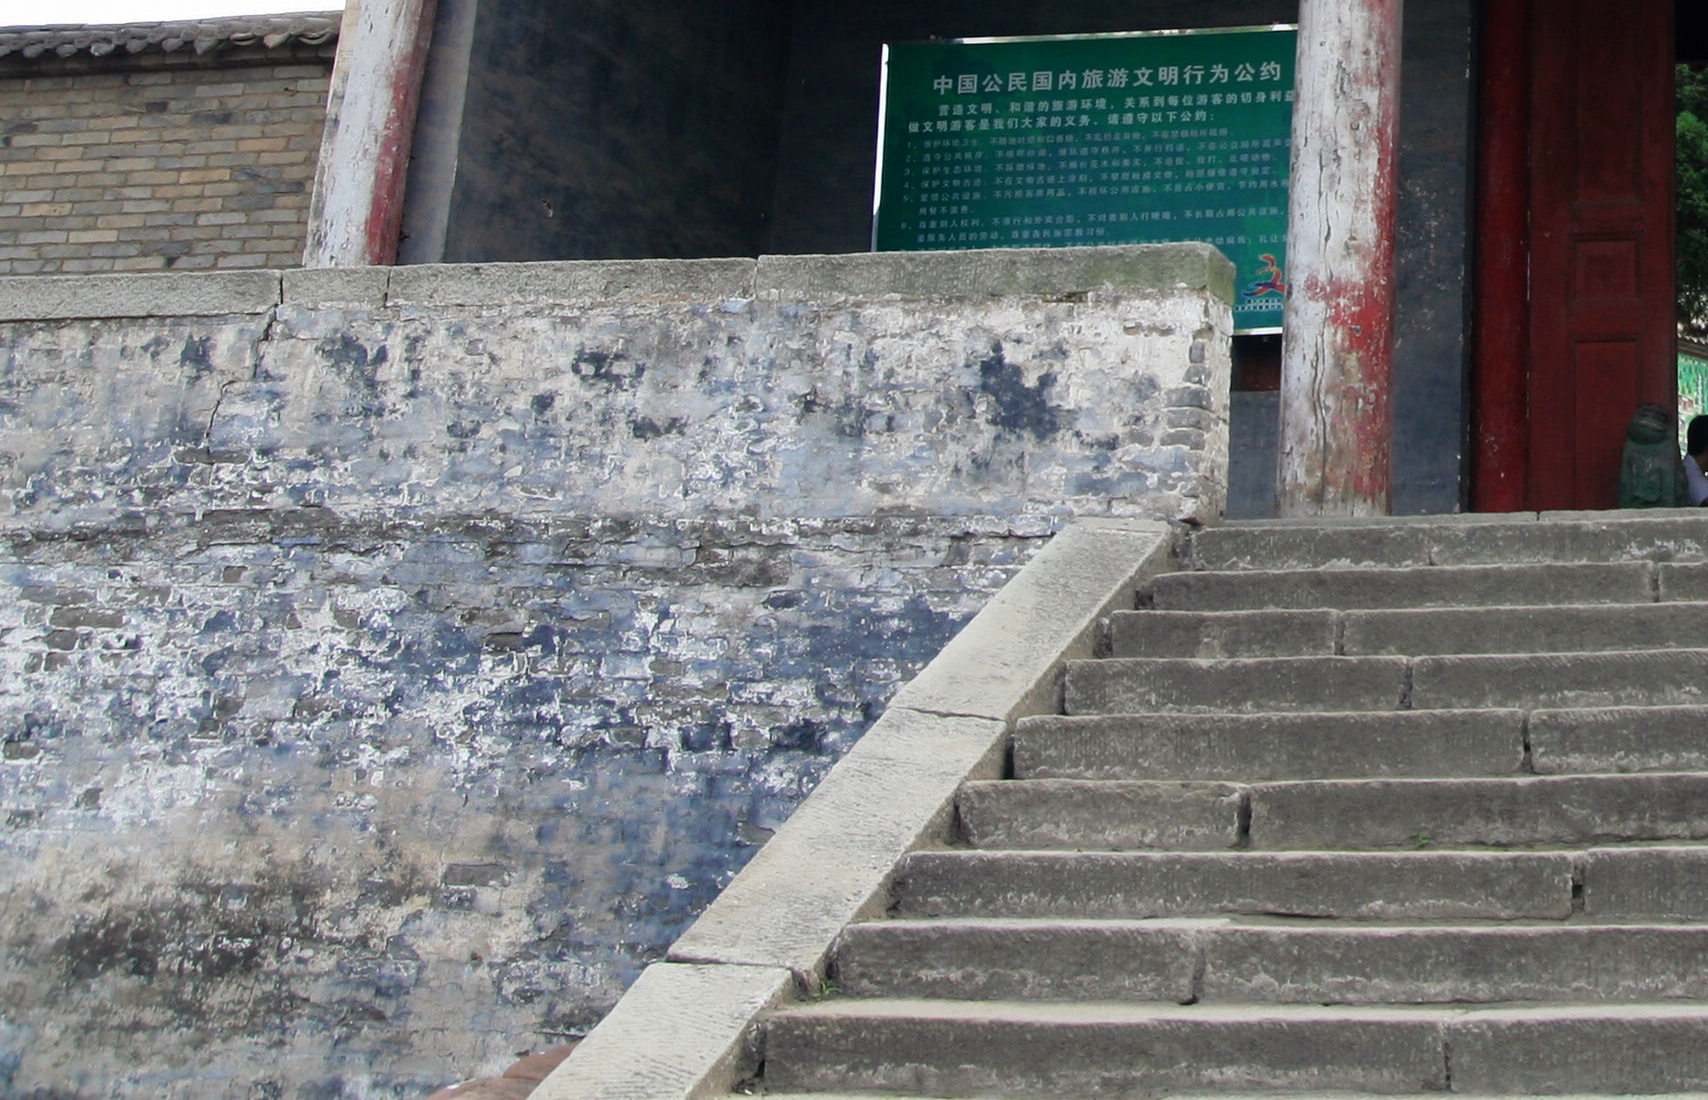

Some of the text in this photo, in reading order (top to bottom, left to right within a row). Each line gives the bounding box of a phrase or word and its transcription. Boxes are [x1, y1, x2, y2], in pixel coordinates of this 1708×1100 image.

[933, 61, 1282, 96] 中国公民国内旅游文明行为公约
